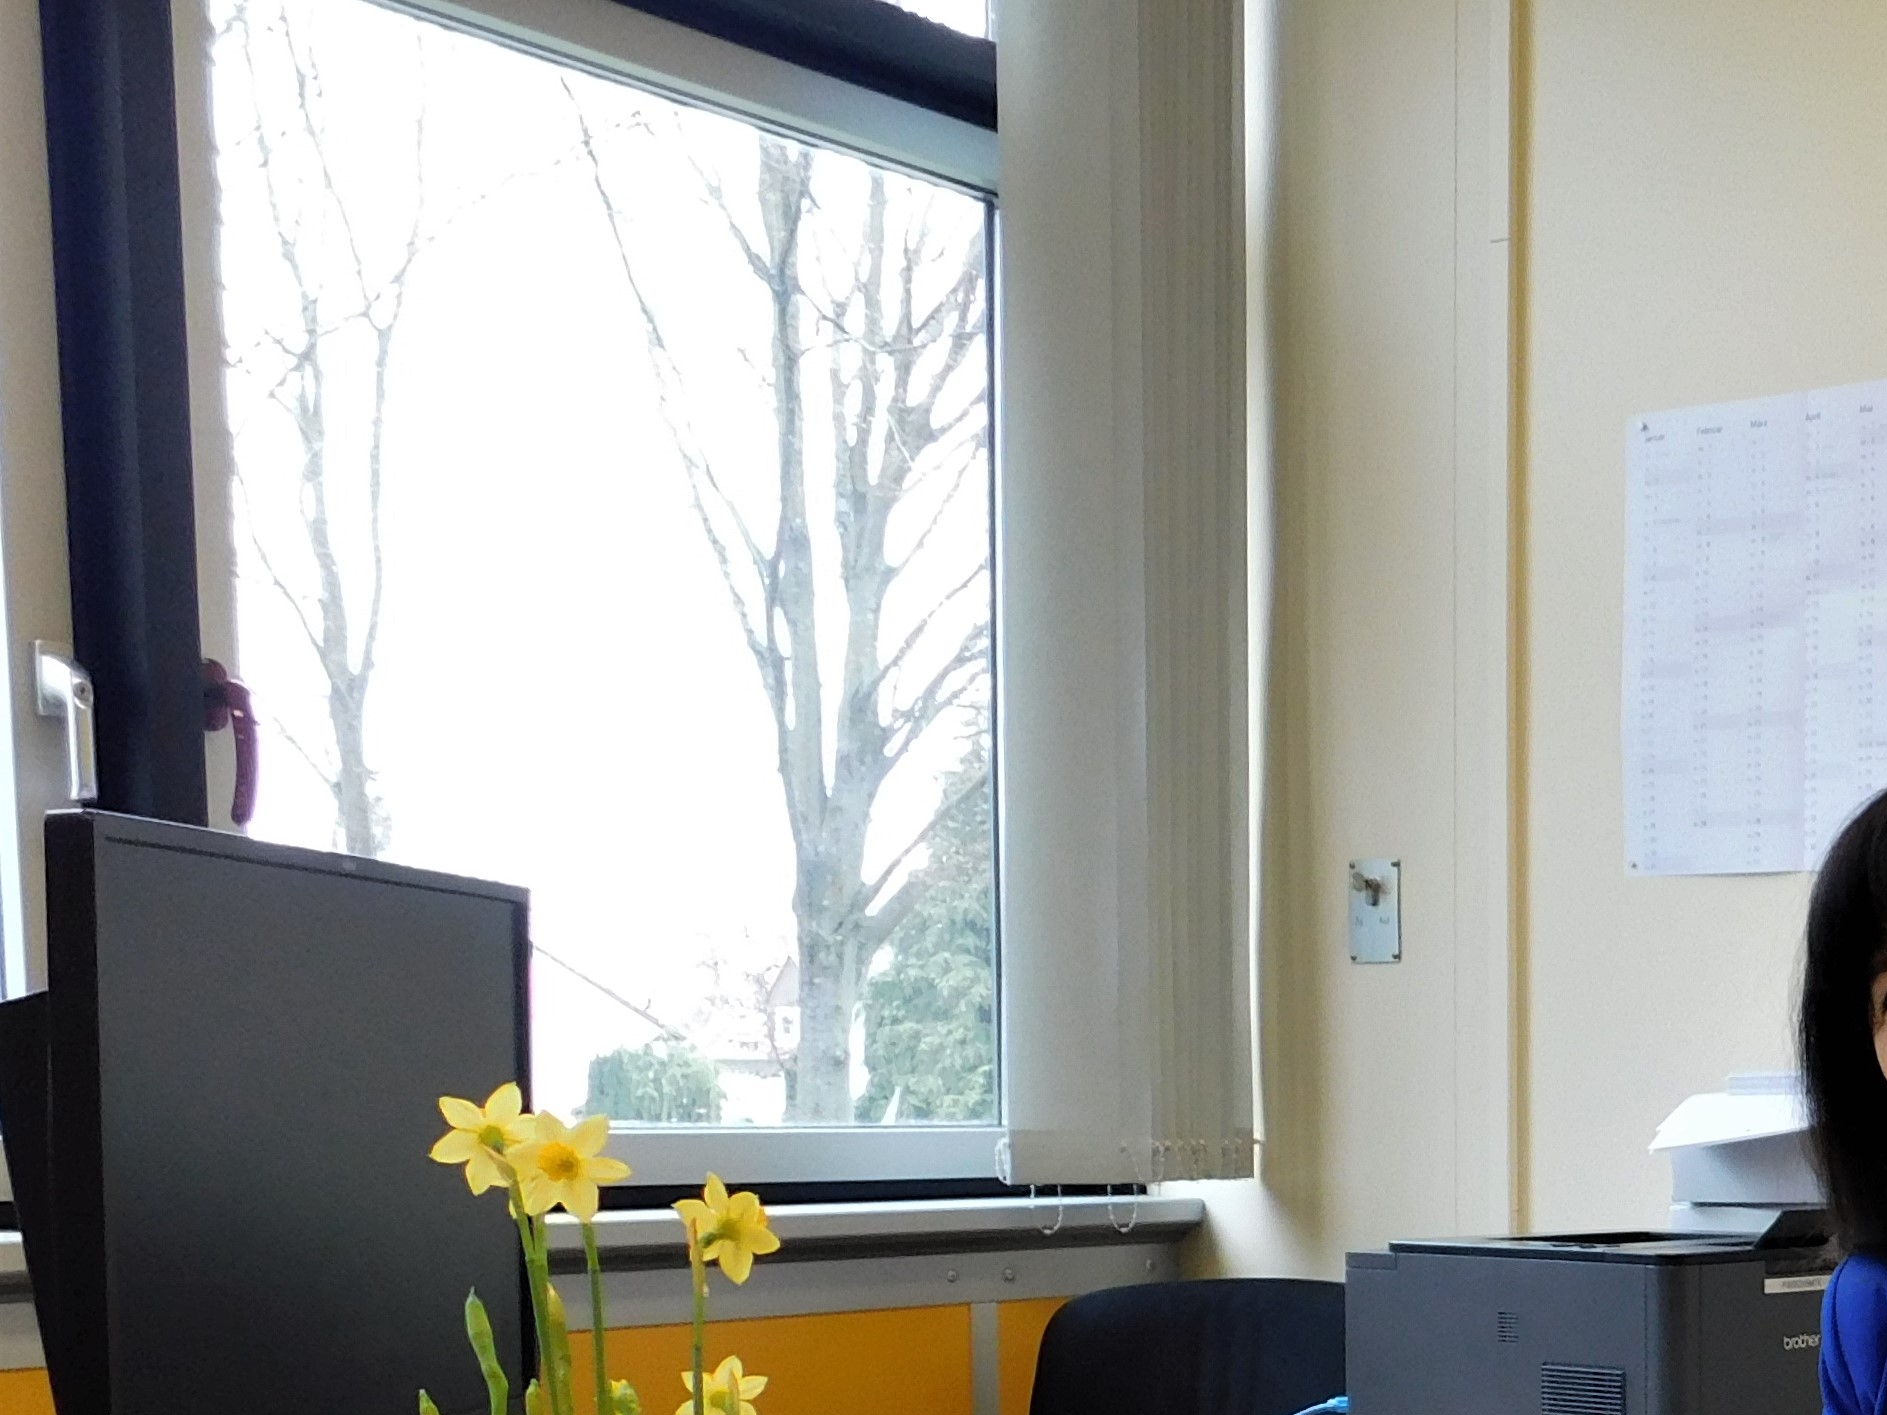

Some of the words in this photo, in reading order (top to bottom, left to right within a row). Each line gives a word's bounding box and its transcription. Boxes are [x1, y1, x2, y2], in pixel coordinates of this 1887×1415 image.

[1859, 404, 1874, 414] Mai
[1805, 411, 1821, 422] April
[1783, 1333, 1820, 1351] brother
